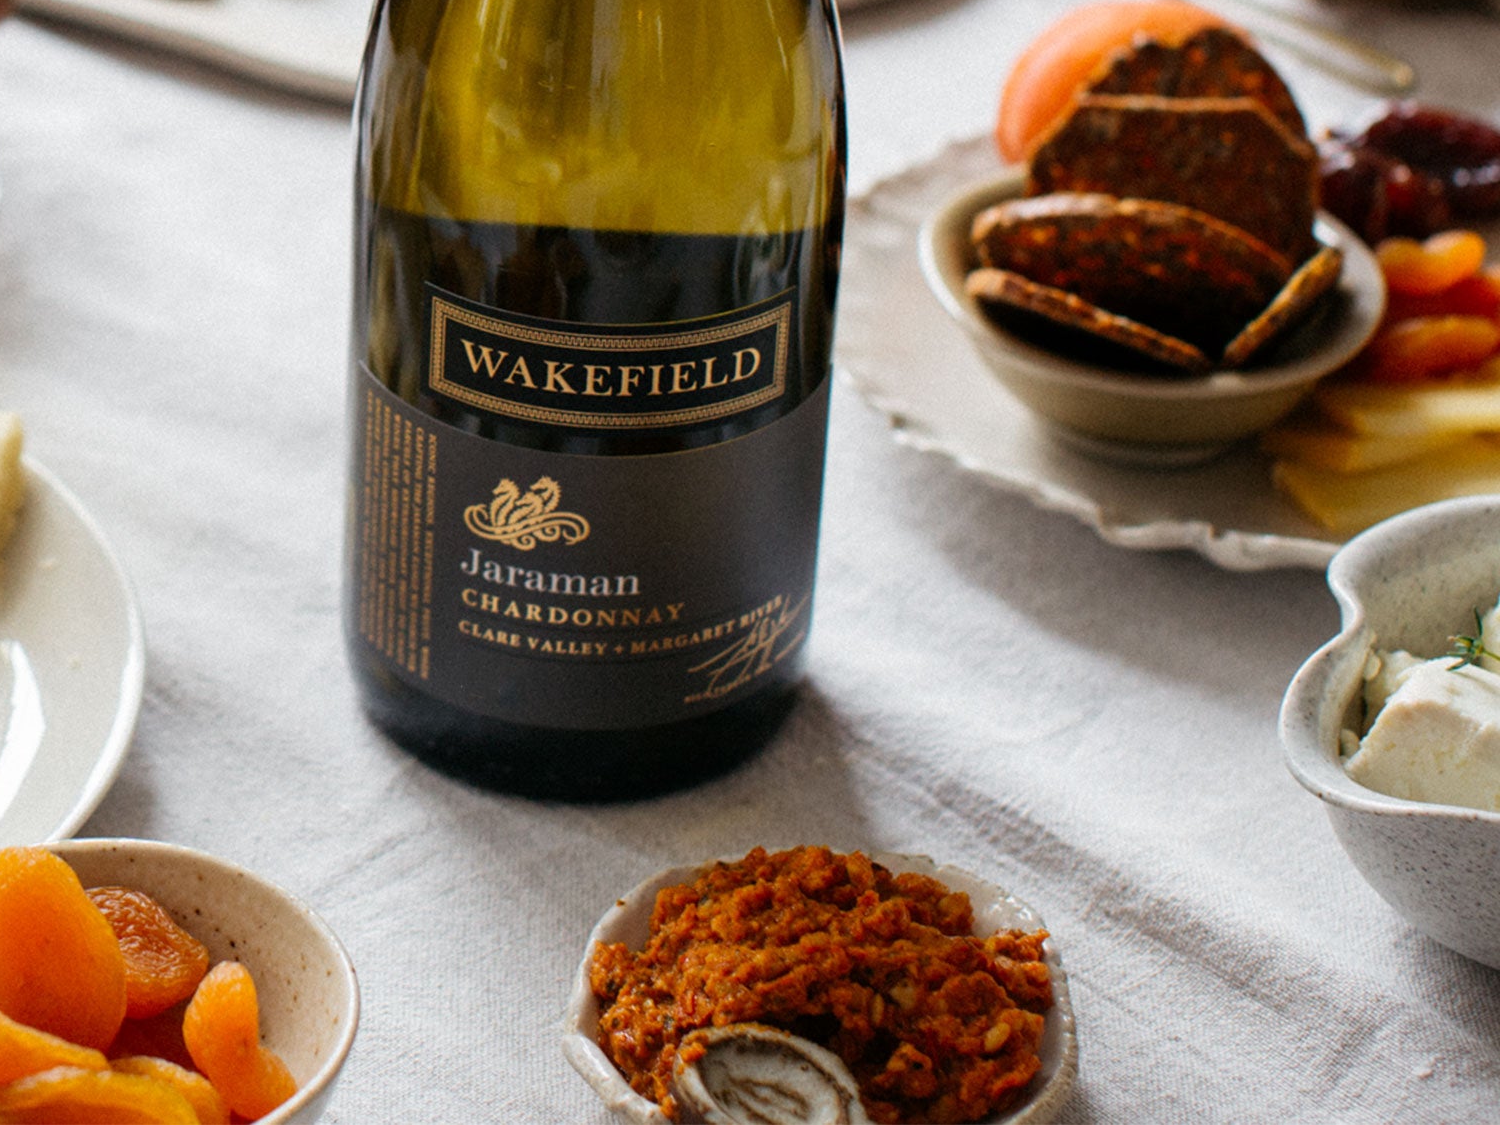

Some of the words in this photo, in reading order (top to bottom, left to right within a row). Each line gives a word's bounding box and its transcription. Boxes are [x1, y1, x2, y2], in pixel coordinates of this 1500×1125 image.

[460, 338, 761, 398] WAKEFIELD
[460, 548, 641, 596] Jaraman
[458, 619, 522, 647] CLARE
[527, 637, 607, 656] VALLEY
[630, 619, 736, 654] MARGARET
[740, 594, 783, 628] RIVER
[461, 588, 685, 627] CHARDONNAY
